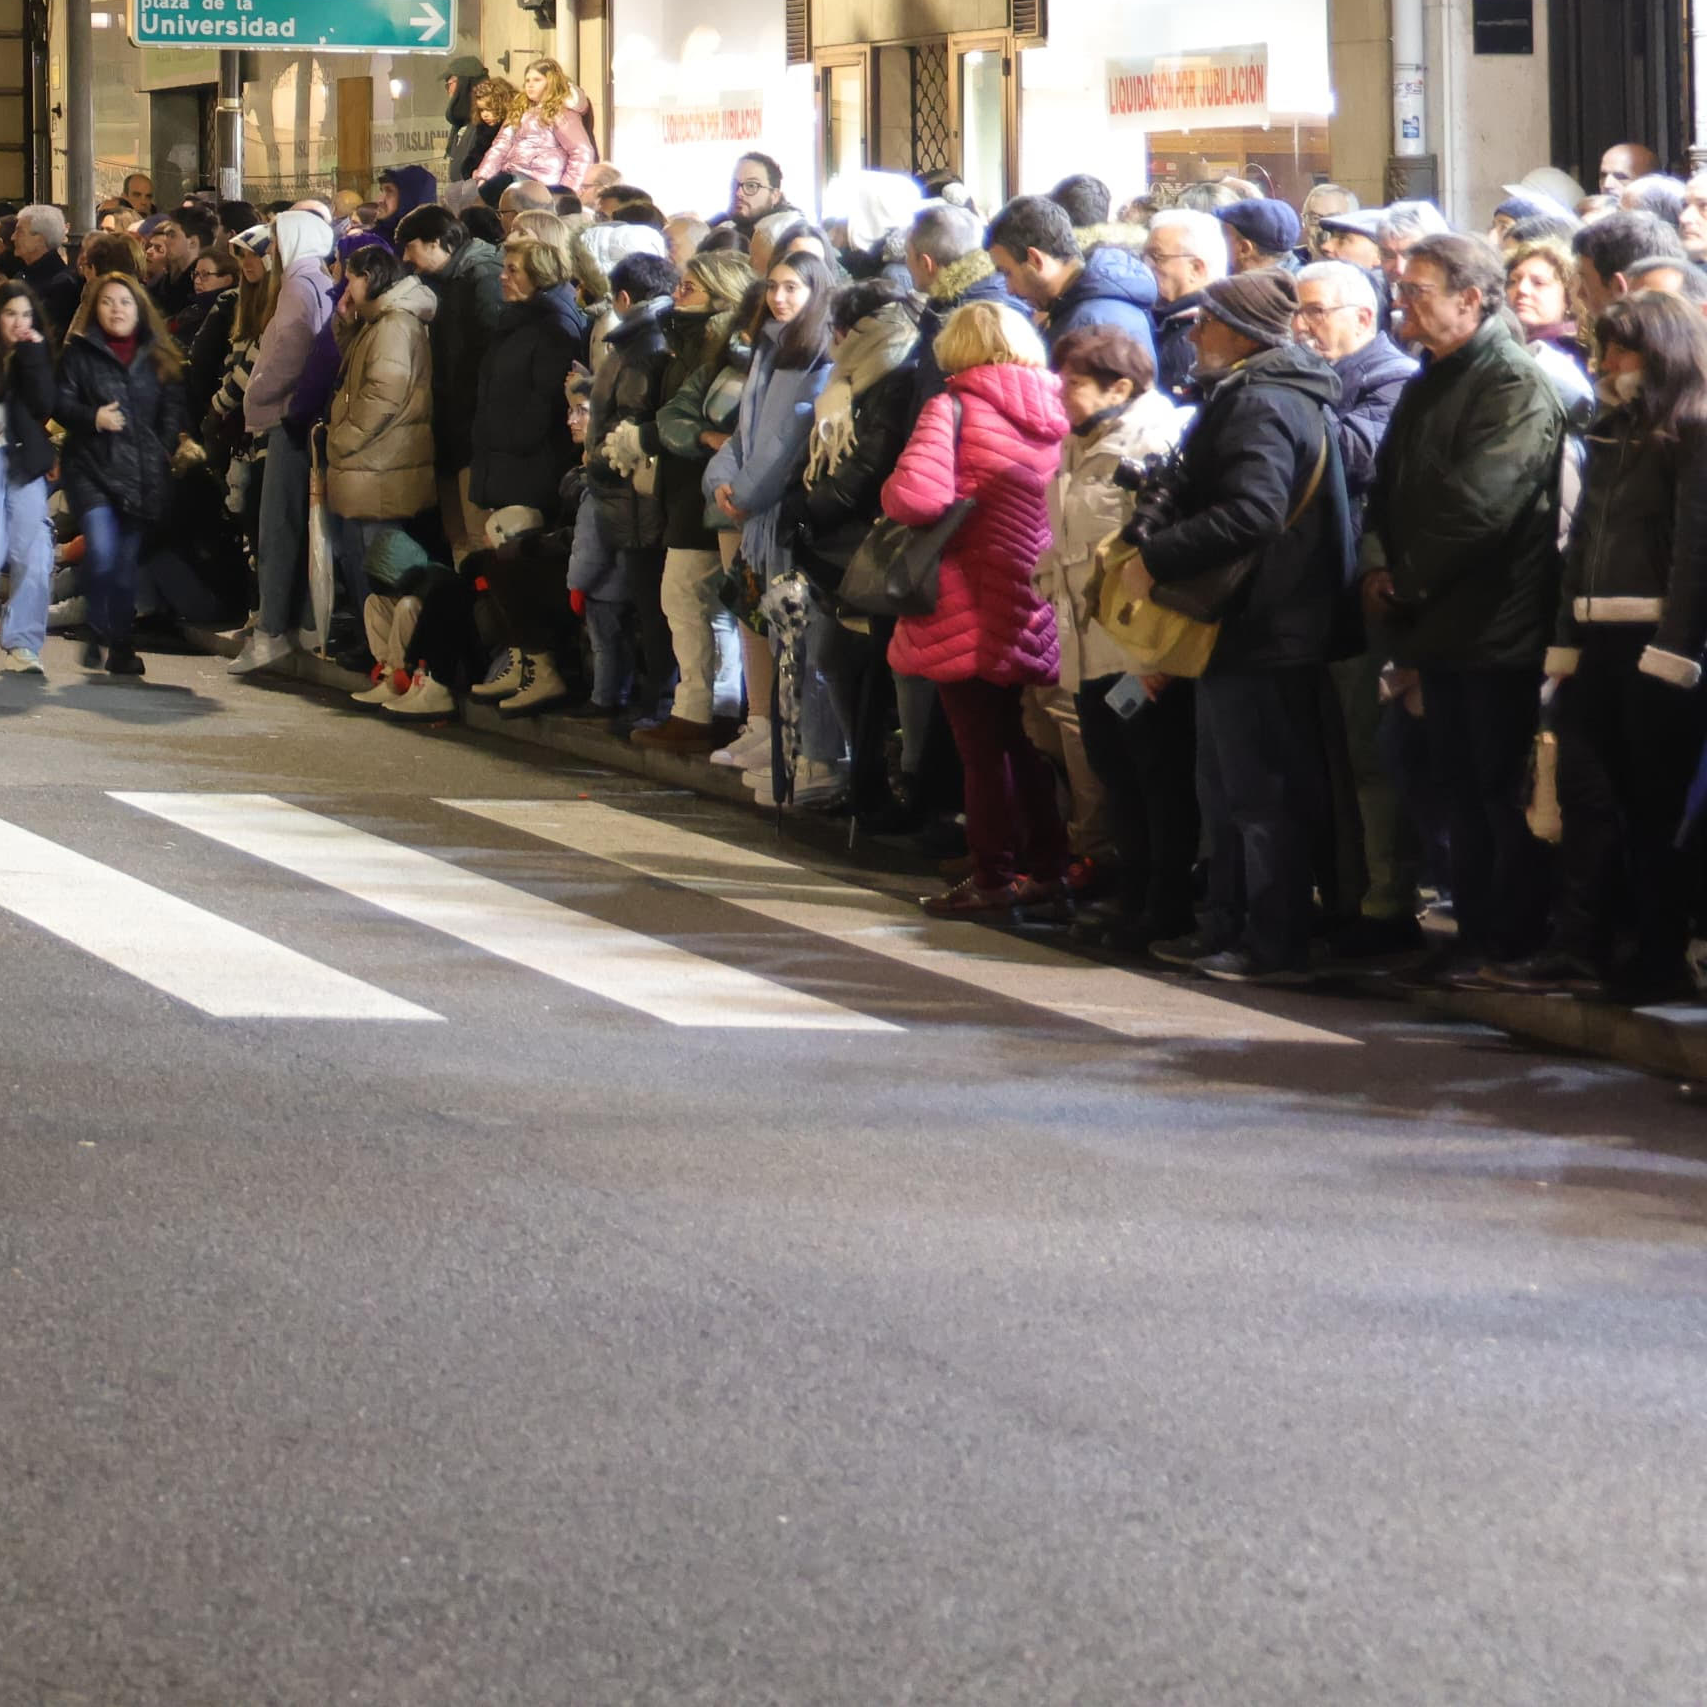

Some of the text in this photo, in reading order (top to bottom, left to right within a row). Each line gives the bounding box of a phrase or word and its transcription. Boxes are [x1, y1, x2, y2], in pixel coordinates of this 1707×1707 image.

[140, 13, 296, 38] Universidad
[1176, 70, 1197, 109] POR
[1199, 54, 1265, 109] JUBILACIÓN
